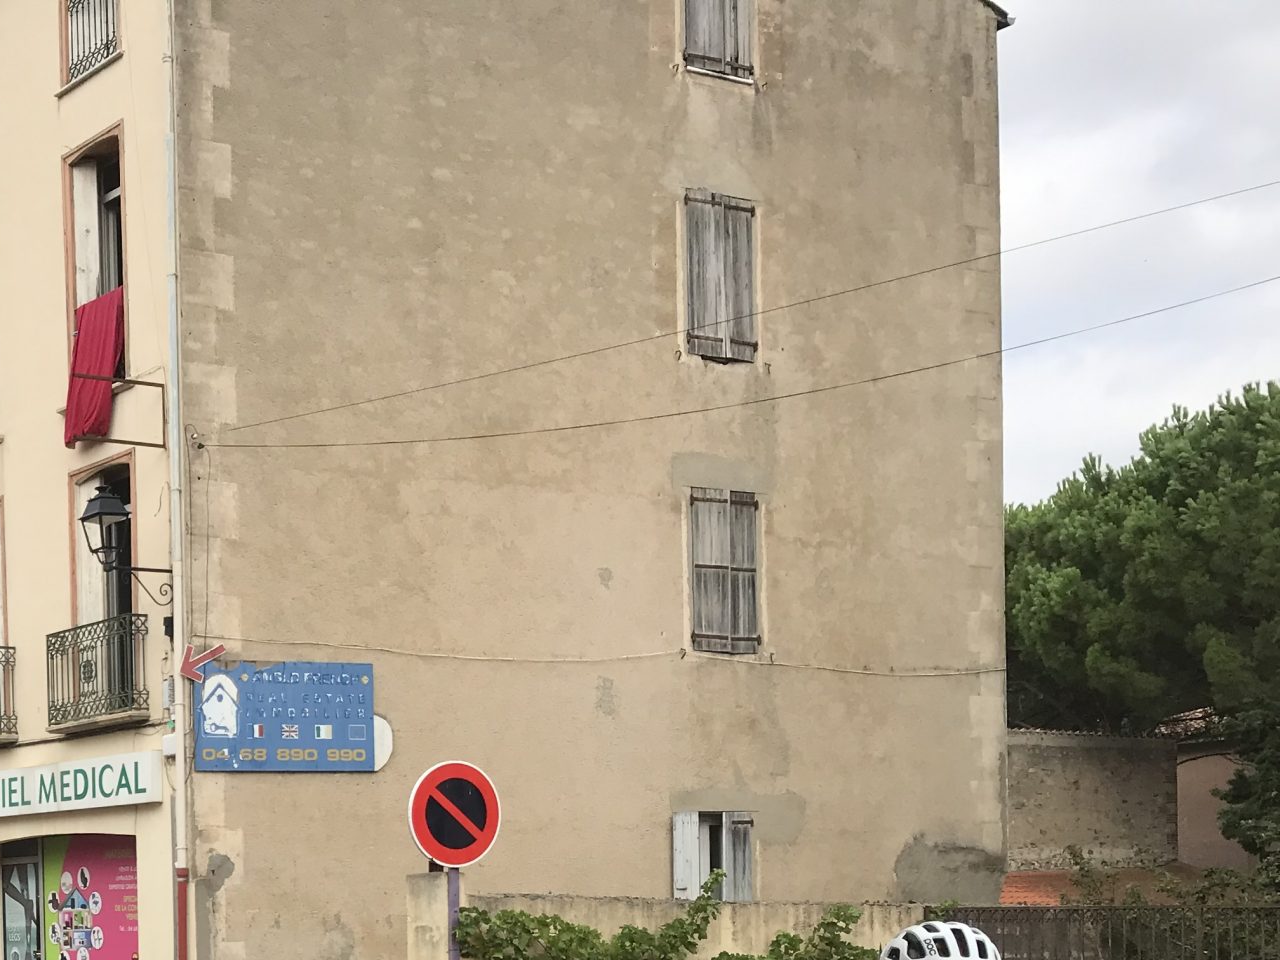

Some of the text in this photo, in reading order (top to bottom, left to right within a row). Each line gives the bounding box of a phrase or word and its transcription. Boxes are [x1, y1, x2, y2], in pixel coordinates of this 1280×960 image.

[202, 748, 366, 761] 04 68 890 990
[38, 761, 147, 804] MEDICAL
